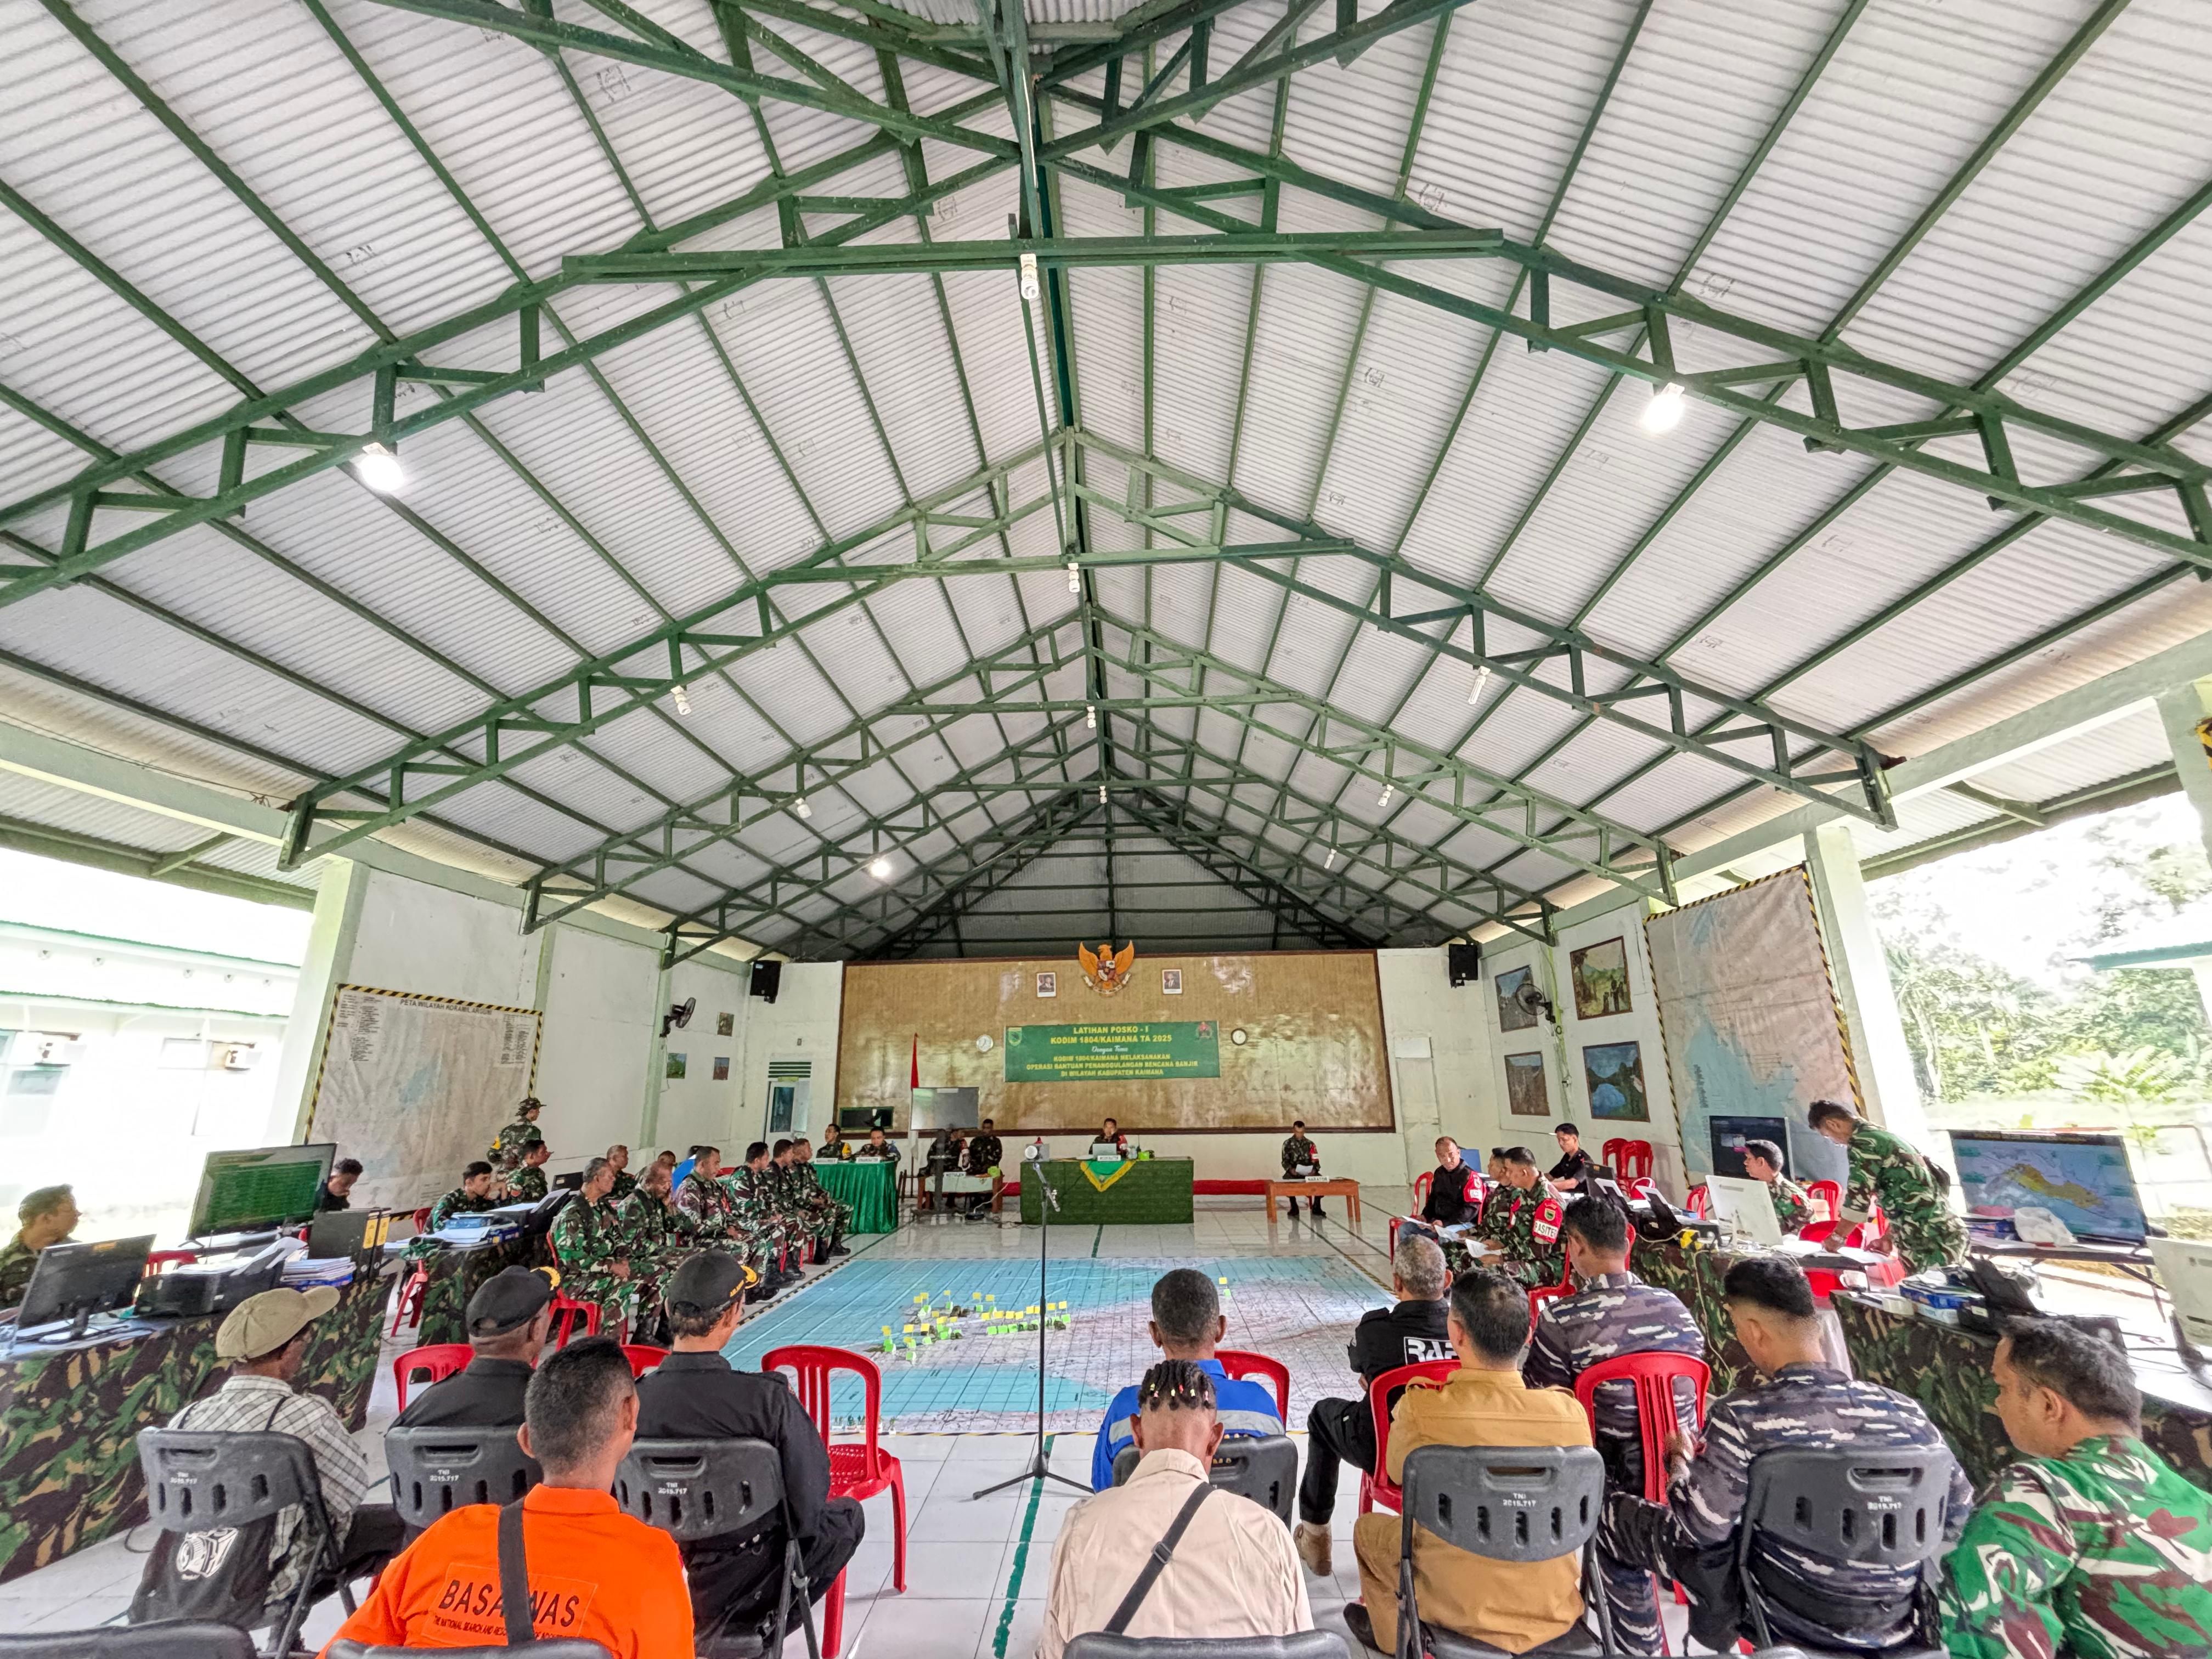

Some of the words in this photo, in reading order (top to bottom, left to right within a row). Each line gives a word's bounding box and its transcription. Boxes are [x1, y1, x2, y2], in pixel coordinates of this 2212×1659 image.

[400, 998, 417, 1007] PETA
[417, 1001, 445, 1009] WILAYAH
[1079, 1035, 1138, 1043] 1804/KAIMANA
[439, 1580, 579, 1627] BASANAS
